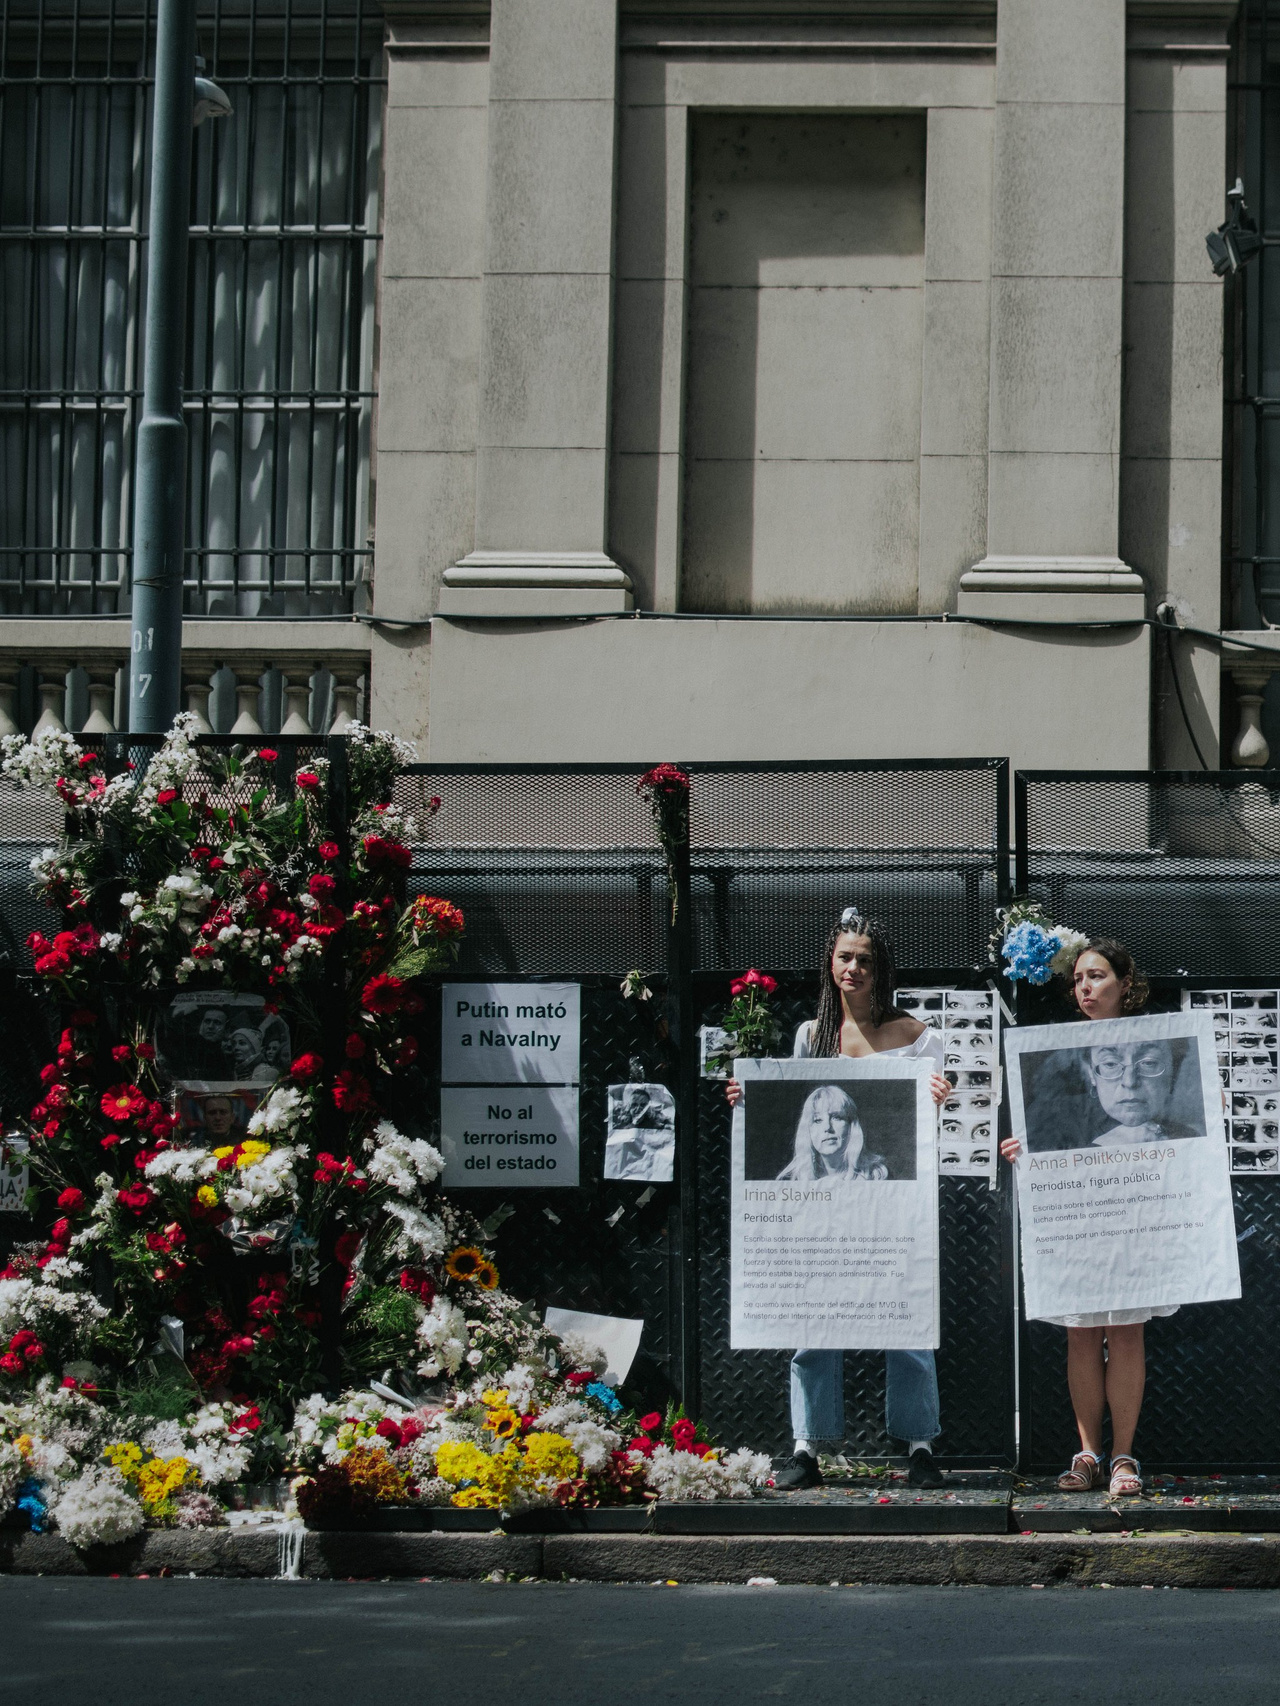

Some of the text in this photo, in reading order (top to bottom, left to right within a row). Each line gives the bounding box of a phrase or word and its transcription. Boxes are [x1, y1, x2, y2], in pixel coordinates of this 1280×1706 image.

[456, 1001, 566, 1018] Putin mató
[461, 1030, 561, 1051] a Navalny
[488, 1105, 532, 1119] No al
[463, 1130, 557, 1144] terrorismo
[465, 1155, 557, 1169] del estado
[1029, 1146, 1175, 1170] Anna Politkóvskaya
[1031, 1172, 1161, 1192] Periodista, figura pública
[744, 1188, 832, 1201] Irina Slavina
[1064, 1201, 1085, 1209] sobre
[1086, 1199, 1093, 1207] el
[1095, 1197, 1125, 1206] conflicto
[744, 1213, 792, 1223] Periodista
[1033, 1215, 1053, 1224] lucha
[1055, 1214, 1078, 1222] contra
[1035, 1233, 1074, 1243] Asesinada
[1075, 1232, 1088, 1241] por
[1100, 1229, 1128, 1238] disparo
[1140, 1225, 1147, 1233] el
[1149, 1224, 1182, 1232] ascensor
[1183, 1221, 1193, 1229] de
